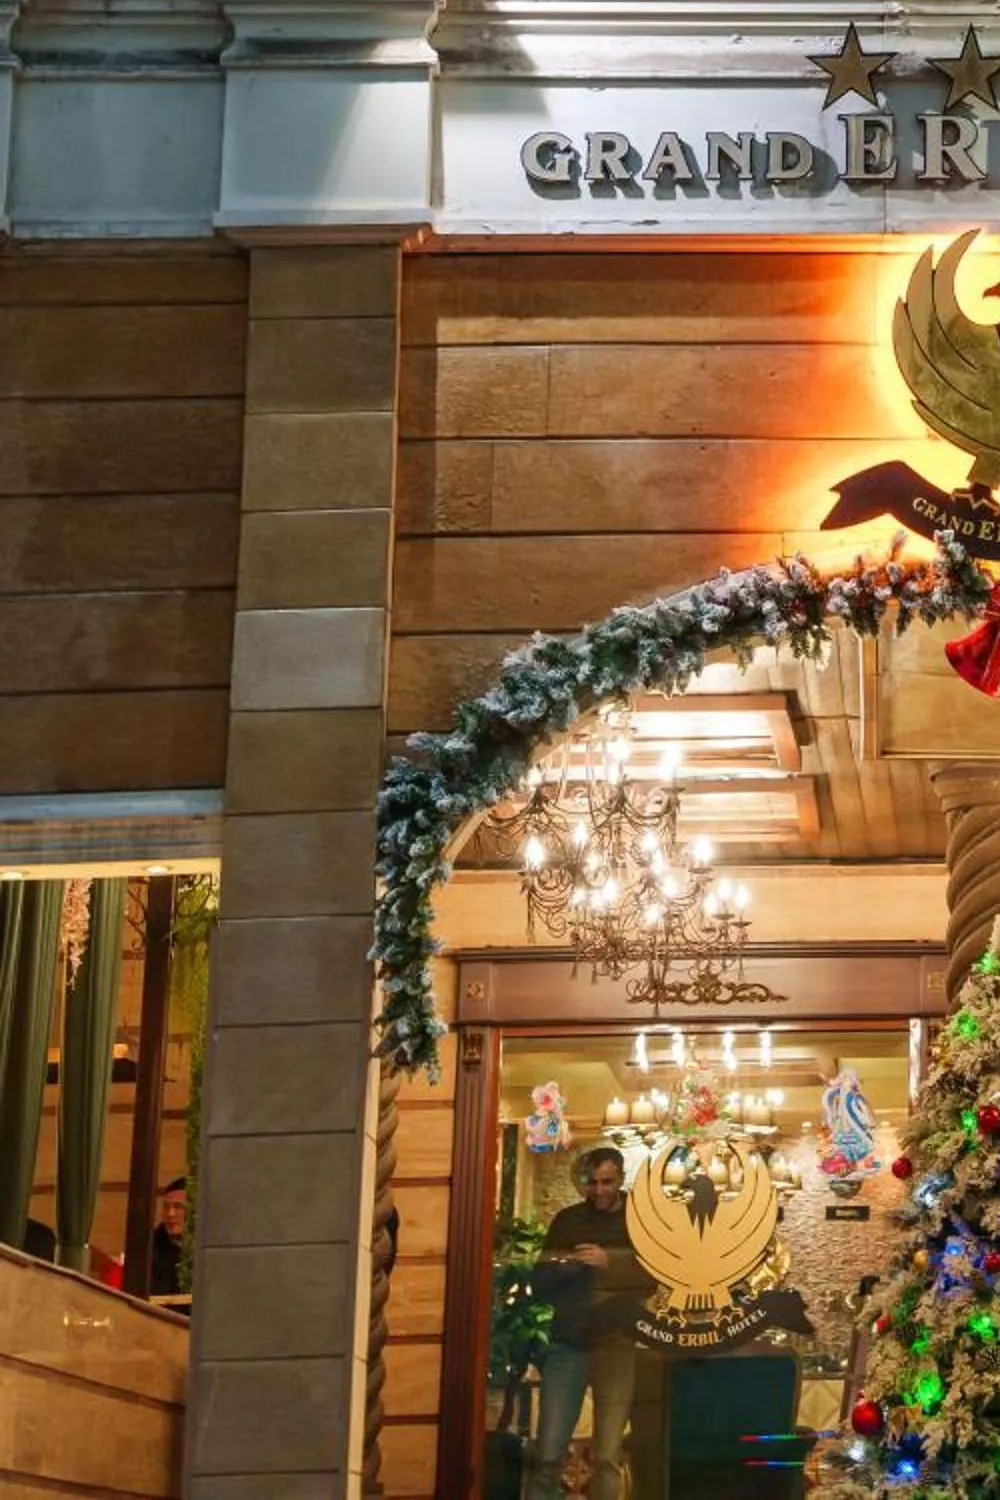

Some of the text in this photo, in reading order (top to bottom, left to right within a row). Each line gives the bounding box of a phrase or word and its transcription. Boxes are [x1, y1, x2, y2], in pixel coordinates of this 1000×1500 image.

[520, 131, 814, 182] GRAND
[911, 496, 975, 536] GRAND
[635, 1320, 674, 1343] GRAND
[726, 1309, 767, 1337] HOTEL
